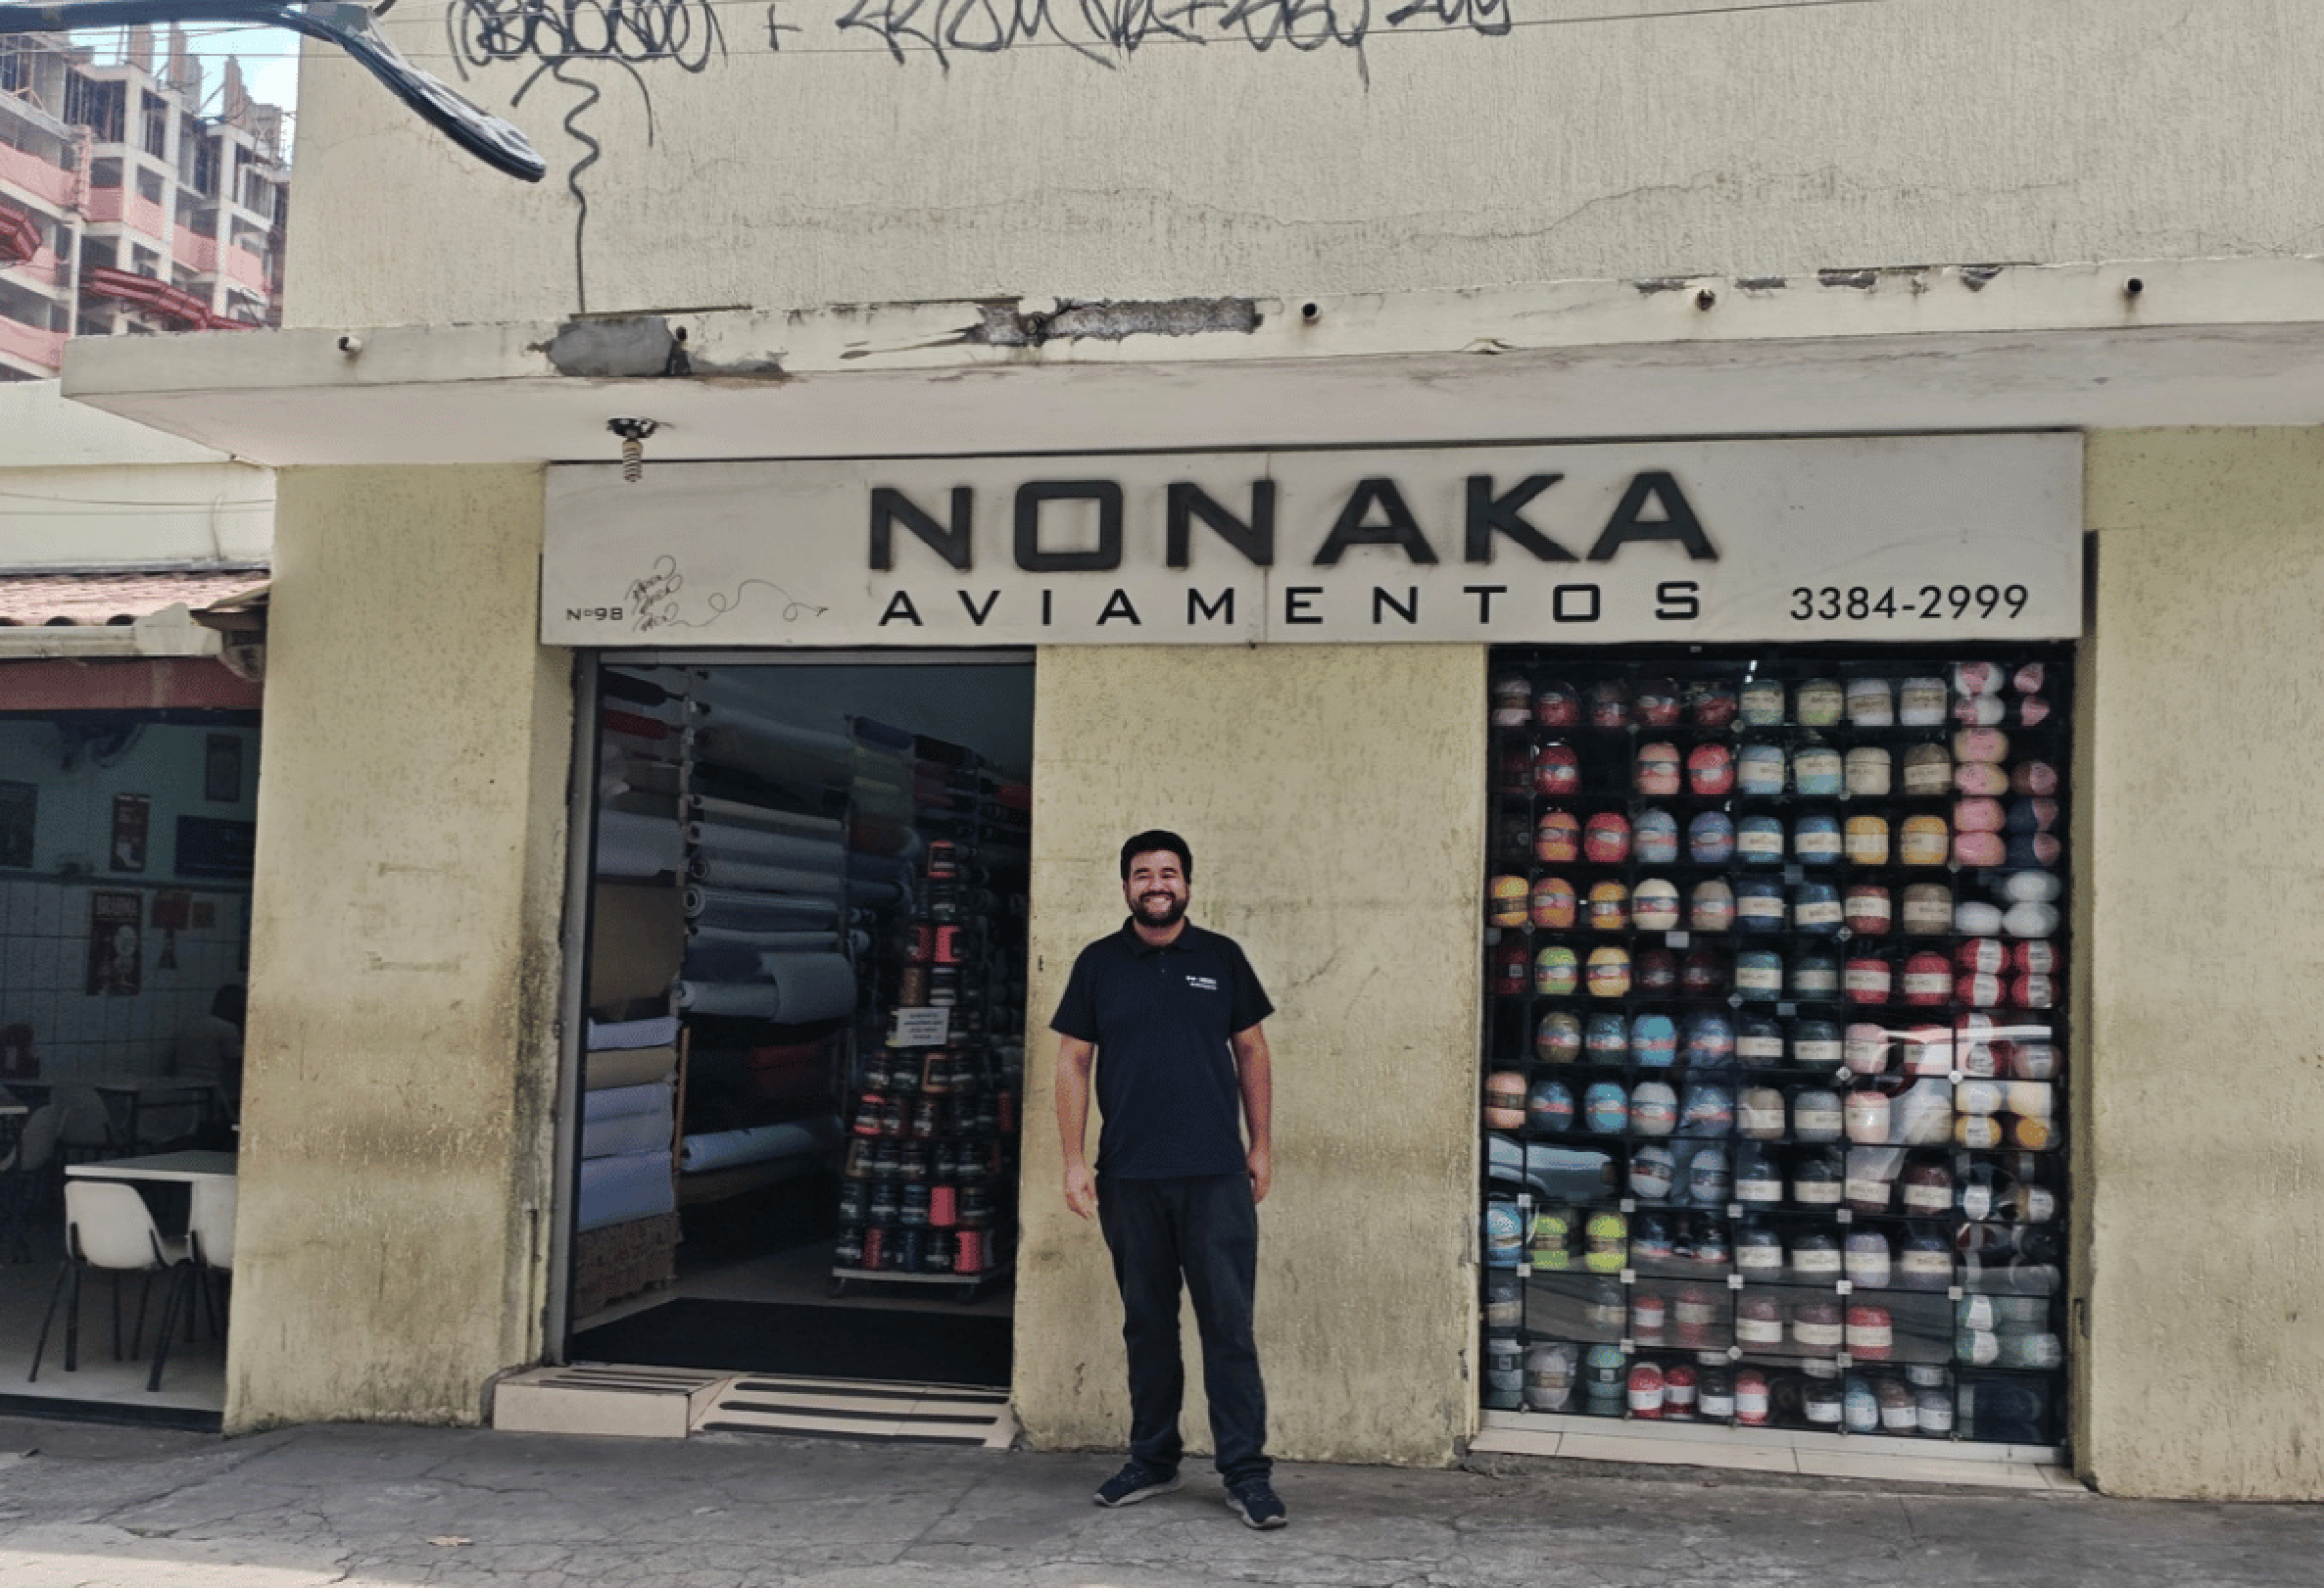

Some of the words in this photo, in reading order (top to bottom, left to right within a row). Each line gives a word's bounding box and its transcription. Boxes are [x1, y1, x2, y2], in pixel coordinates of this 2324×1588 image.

[869, 470, 1720, 572] NONAKA
[878, 579, 1700, 626] AVIAMENTOS
[1790, 584, 2029, 620] 3384-2999
